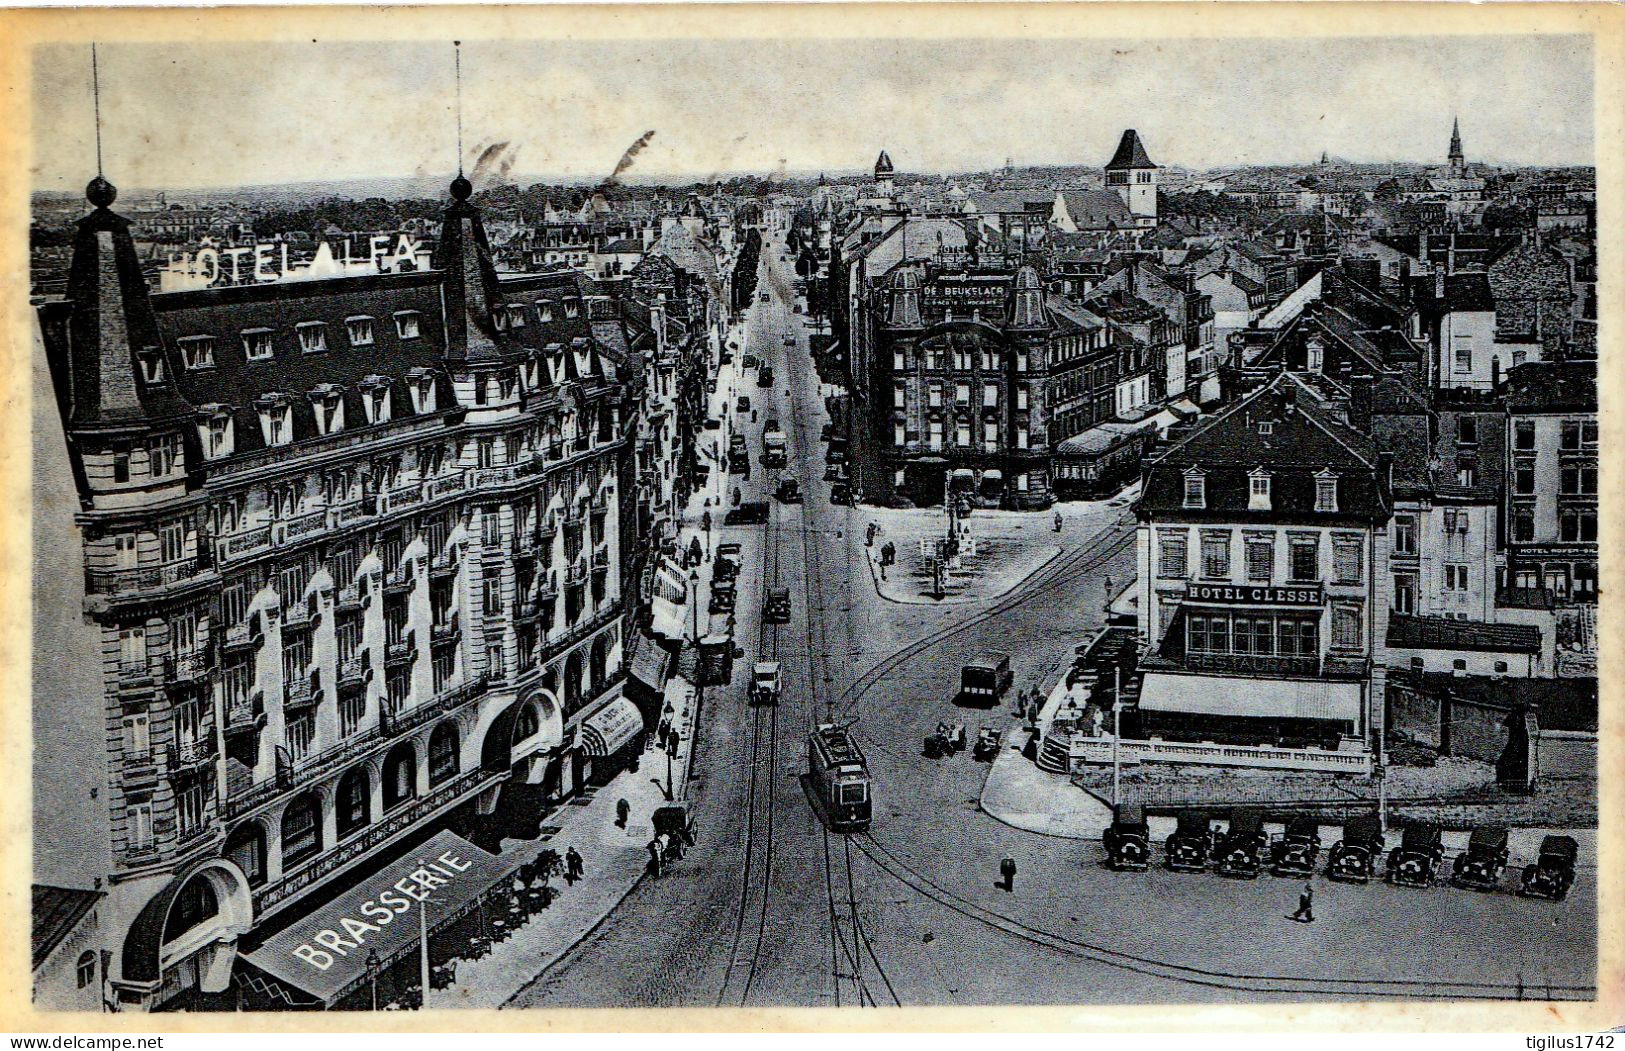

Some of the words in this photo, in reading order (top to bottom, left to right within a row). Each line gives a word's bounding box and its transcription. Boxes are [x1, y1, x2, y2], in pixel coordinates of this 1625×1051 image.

[167, 236, 295, 287] HÔTEL
[309, 234, 424, 277] ALFA
[923, 286, 937, 295] DE
[1189, 586, 1244, 600] HOTEL
[1251, 588, 1319, 603] CLESSE
[1186, 654, 1316, 673] RESTAURANT
[292, 850, 473, 971] BRASSERIE
